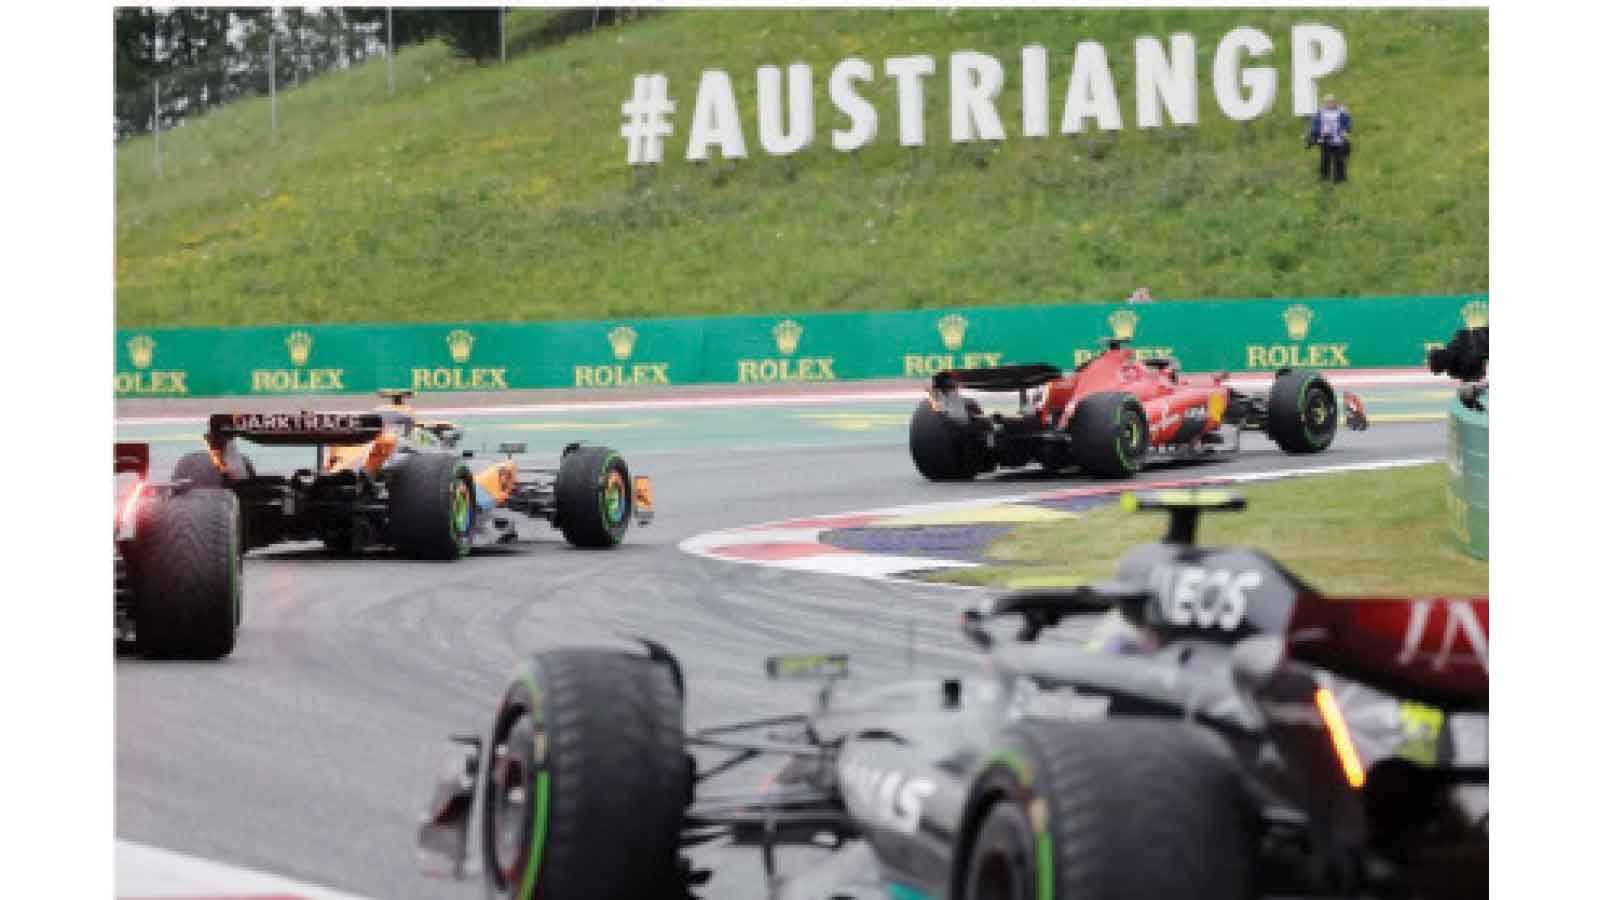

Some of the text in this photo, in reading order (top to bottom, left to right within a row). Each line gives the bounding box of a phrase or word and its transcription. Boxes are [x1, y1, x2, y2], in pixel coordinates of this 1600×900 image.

[620, 24, 1348, 164] #AUSTRIANGP
[1246, 343, 1349, 368] ROLEX
[252, 368, 344, 391] ROLEX
[411, 367, 508, 389] ROLEX
[575, 363, 672, 386] ROLEX
[738, 356, 835, 381] ROLEX
